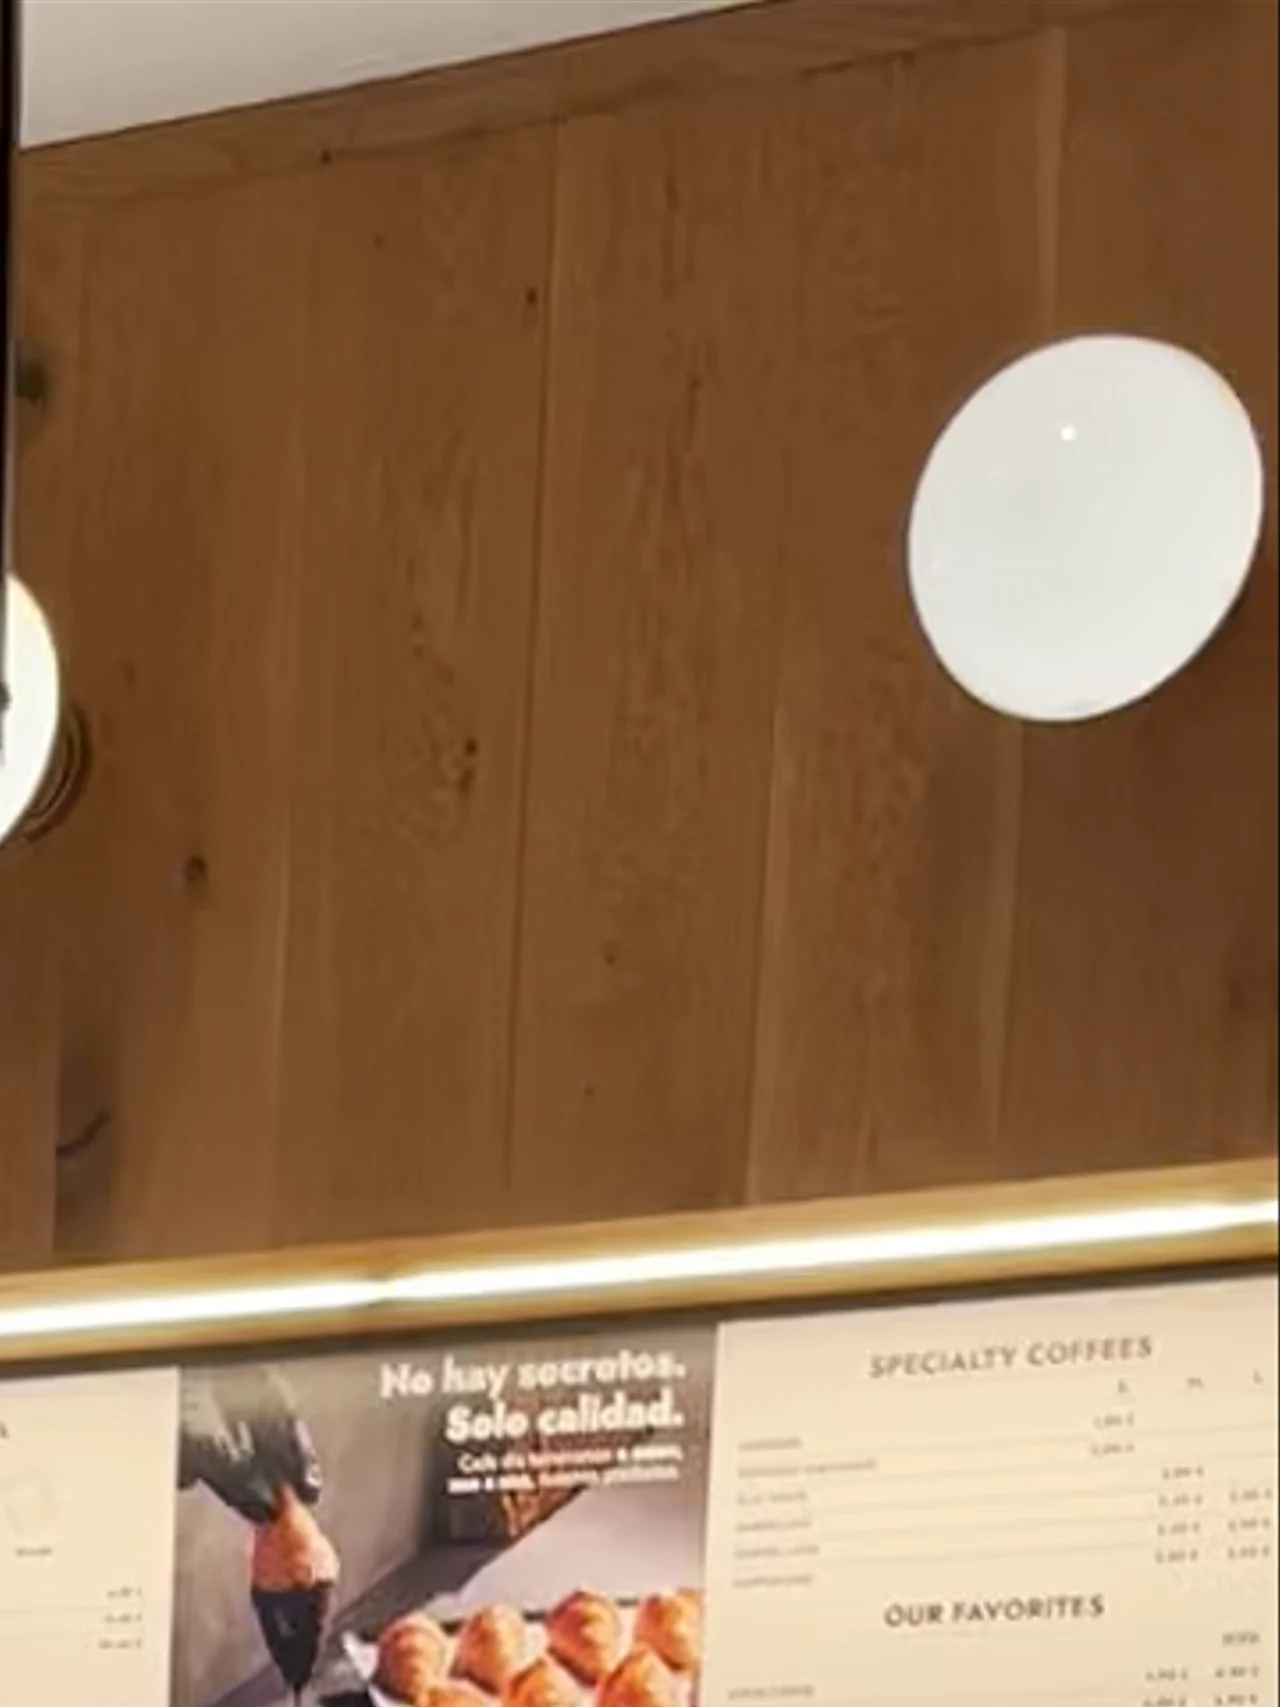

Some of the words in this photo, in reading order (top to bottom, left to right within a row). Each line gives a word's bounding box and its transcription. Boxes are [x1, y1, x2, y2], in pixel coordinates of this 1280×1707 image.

[380, 1361, 434, 1398] No
[441, 1353, 509, 1399] hay
[869, 1344, 1017, 1380] SPECIALTY
[1027, 1335, 1153, 1367] COFFEES
[445, 1400, 529, 1443] Solo
[536, 1386, 685, 1435] calidad.
[883, 1603, 944, 1629] OUR
[951, 1594, 1106, 1623] FAVORITES
